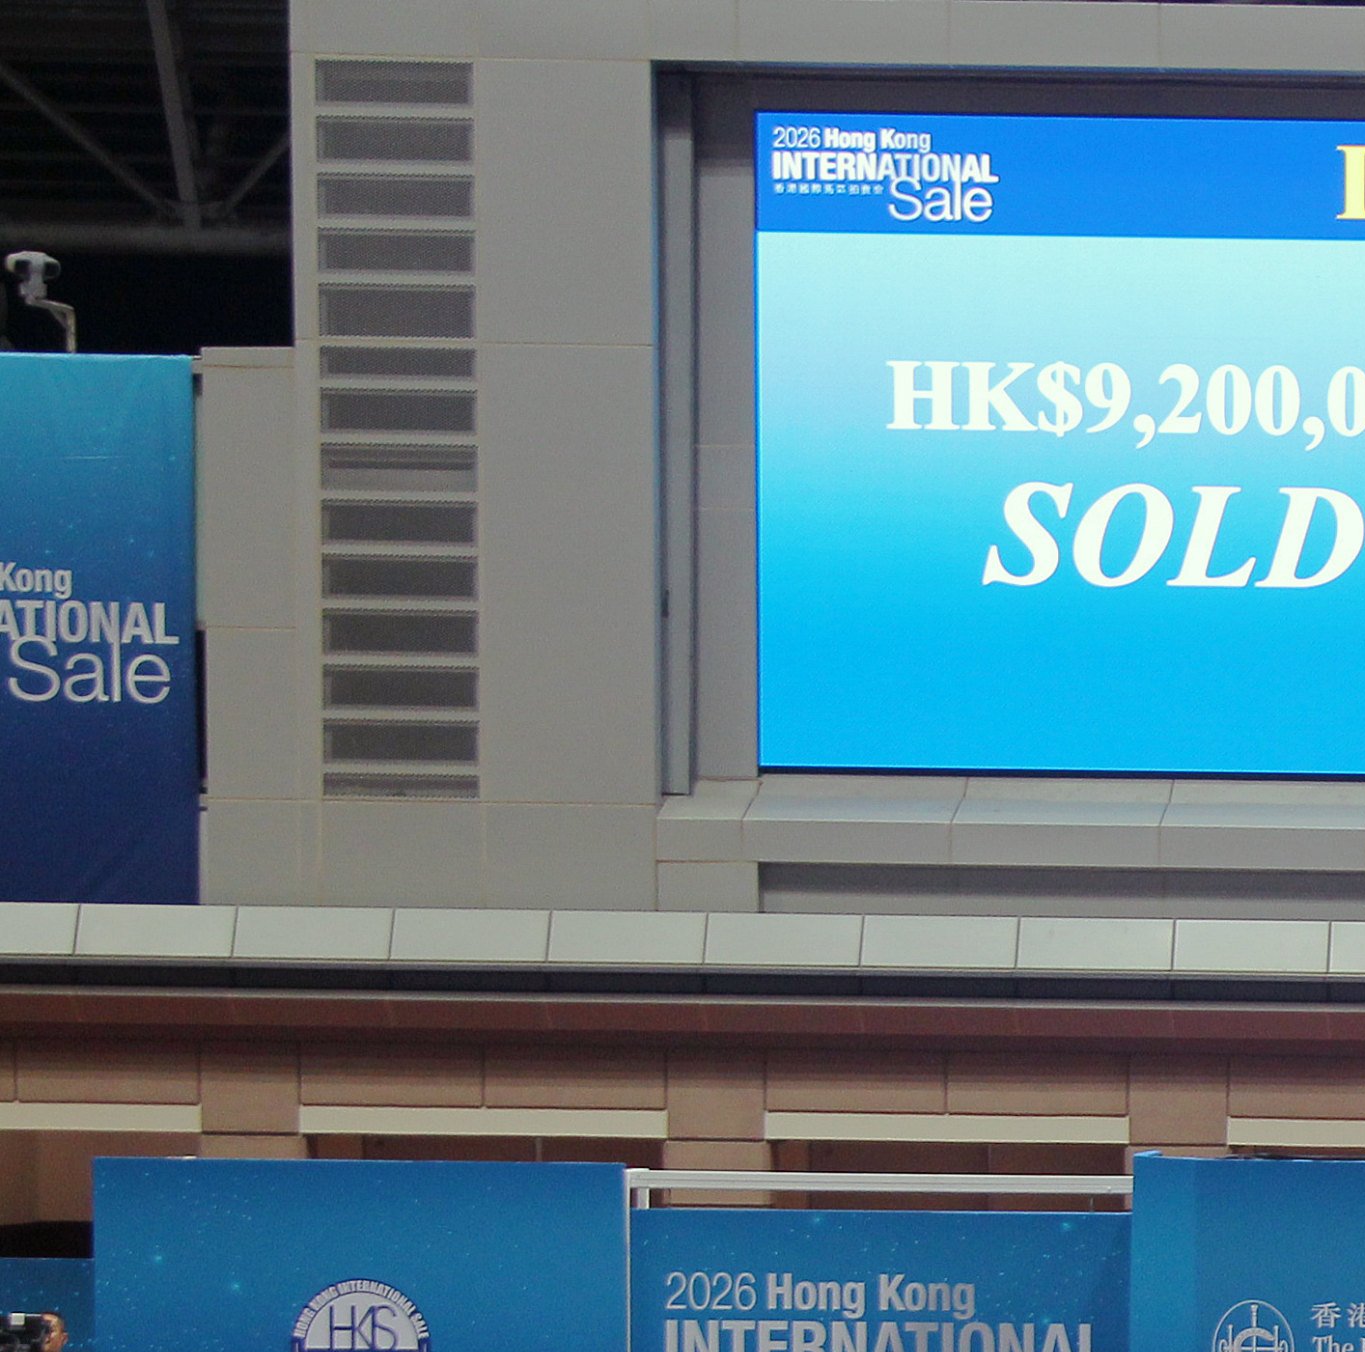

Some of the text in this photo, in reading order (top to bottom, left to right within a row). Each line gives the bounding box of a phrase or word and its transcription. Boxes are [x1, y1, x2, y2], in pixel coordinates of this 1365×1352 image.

[773, 127, 931, 153] 2026 Hong Kong
[772, 152, 1000, 183] INTERNATIONAL
[888, 177, 993, 222] Sale
[983, 482, 1364, 587] SOLD
[0, 562, 72, 599] Kong
[8, 634, 171, 704] Sale
[293, 1279, 430, 1338] HONG KONG INTERNATIONAL SALE
[665, 1272, 975, 1320] 2026 Hong Kong
